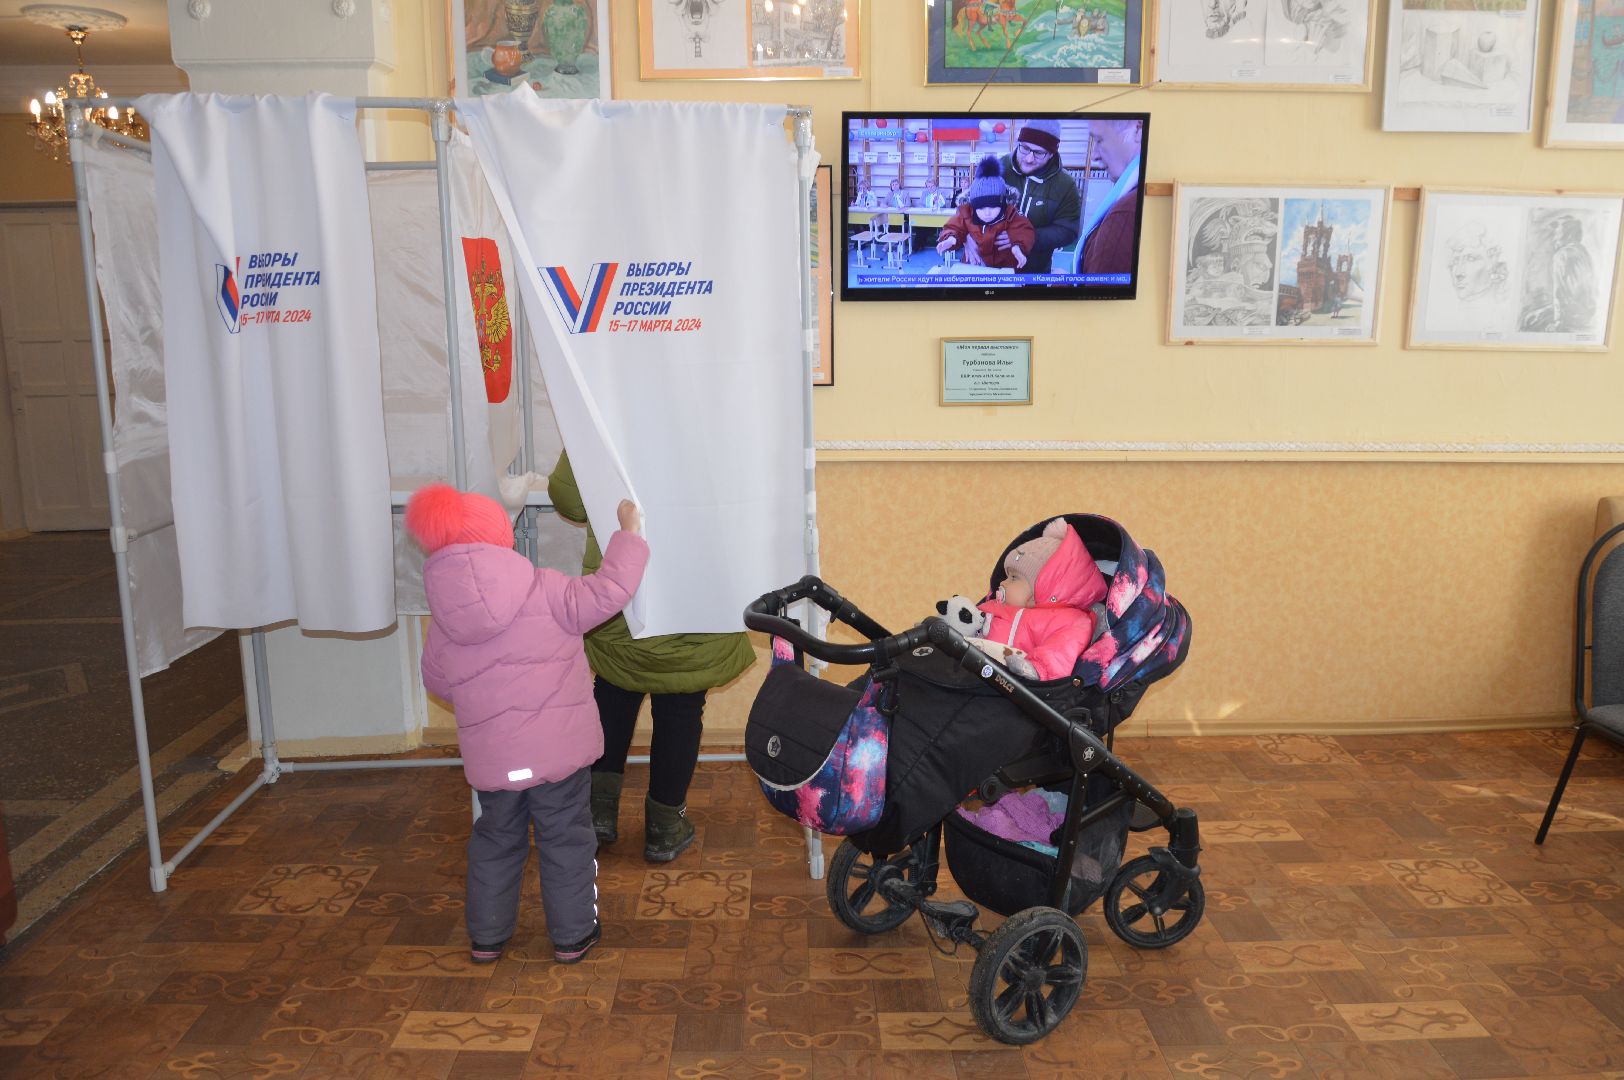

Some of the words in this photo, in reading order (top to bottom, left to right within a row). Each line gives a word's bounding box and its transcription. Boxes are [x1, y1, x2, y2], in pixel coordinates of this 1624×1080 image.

[626, 261, 692, 277] ВЫБОРЫ
[891, 275, 916, 283] России
[943, 275, 997, 284] избирательные
[619, 280, 713, 298] ПРЕЗИДЕНТА
[282, 309, 312, 323] 2024
[612, 301, 672, 316] РОССИИ
[638, 319, 673, 333] МАРТА
[673, 318, 702, 332] 2024
[995, 674, 1015, 693] DOLCE
